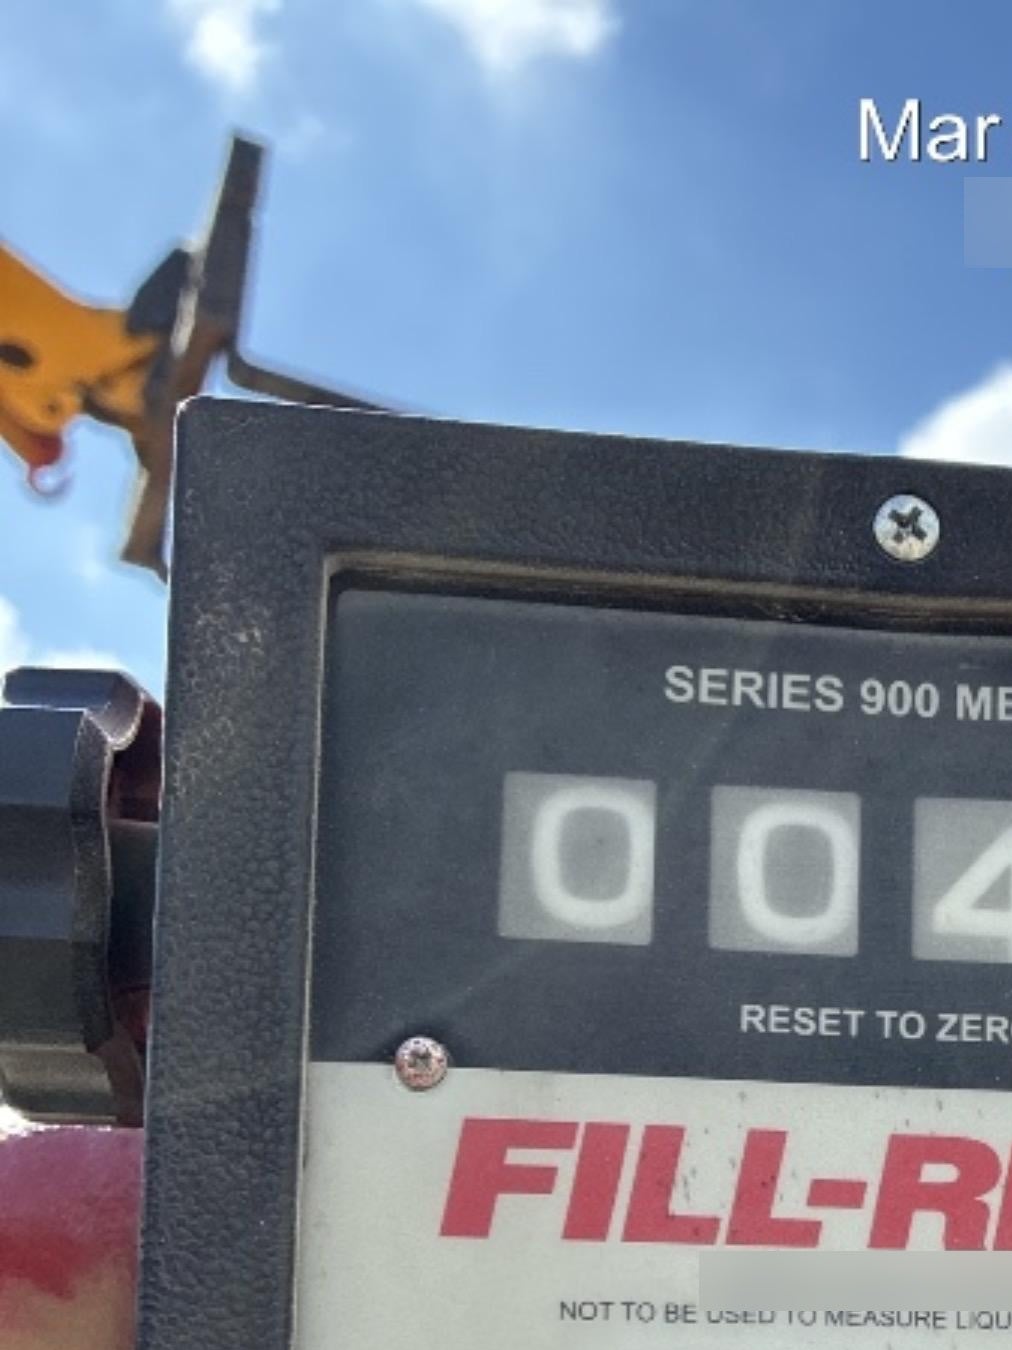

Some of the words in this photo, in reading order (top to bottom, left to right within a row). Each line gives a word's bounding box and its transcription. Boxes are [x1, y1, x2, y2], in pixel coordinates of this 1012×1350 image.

[664, 664, 844, 712] SERIES
[859, 679, 940, 719] 900
[739, 1004, 865, 1039] RESET
[876, 1010, 924, 1041] TO
[559, 1301, 615, 1321] NOT
[621, 1302, 655, 1323] TO
[664, 1304, 698, 1324] BE
[706, 1311, 776, 1324] USED
[786, 1311, 816, 1326] TO
[824, 1311, 947, 1329] MEASURE
